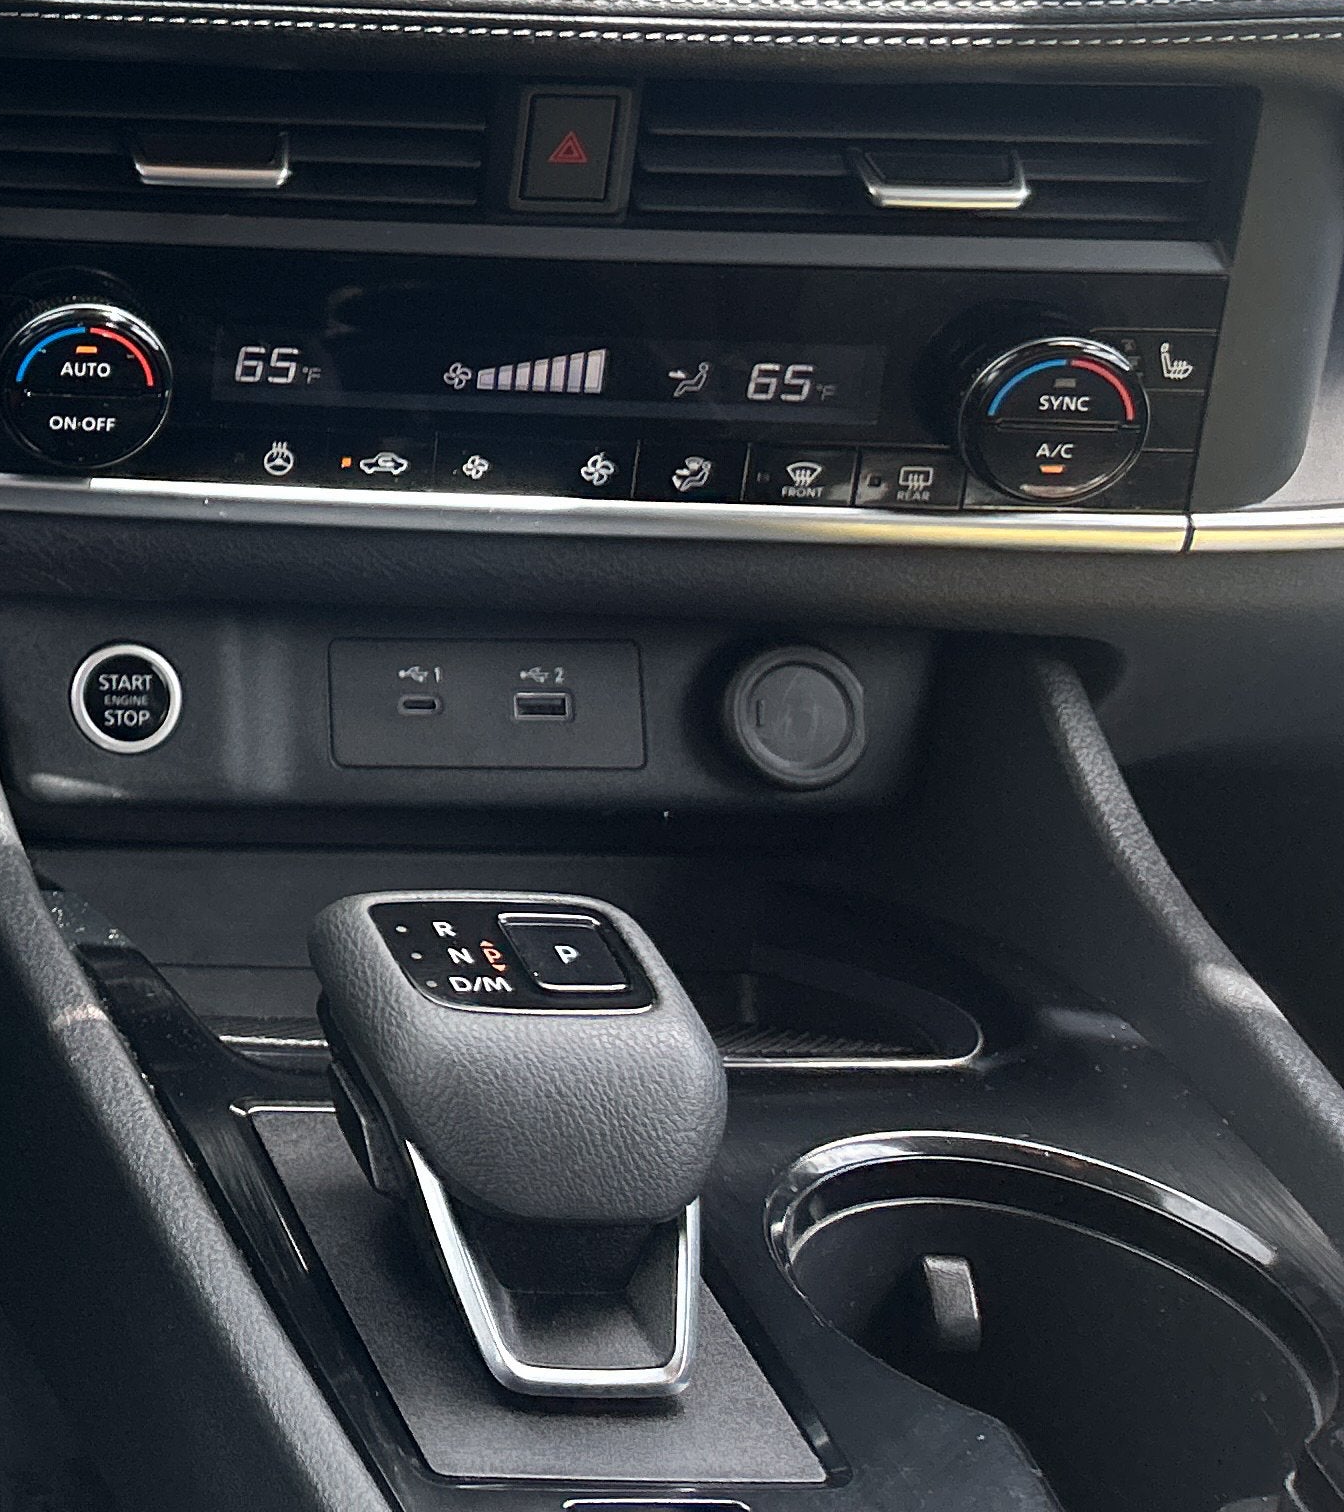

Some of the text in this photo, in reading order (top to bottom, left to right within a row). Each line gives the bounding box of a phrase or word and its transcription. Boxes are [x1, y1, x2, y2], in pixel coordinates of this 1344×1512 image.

[60, 361, 111, 379] AUTO
[1038, 395, 1090, 413] SYNC
[1035, 443, 1075, 460] A/C
[781, 486, 824, 498] FRONT
[897, 490, 930, 502] REAR
[98, 673, 153, 691] START
[104, 694, 148, 706] ENGINE
[104, 709, 150, 727] STOP
[432, 920, 457, 938] R
[447, 947, 475, 966] N
[554, 945, 580, 964] P
[448, 975, 513, 993] D/M
